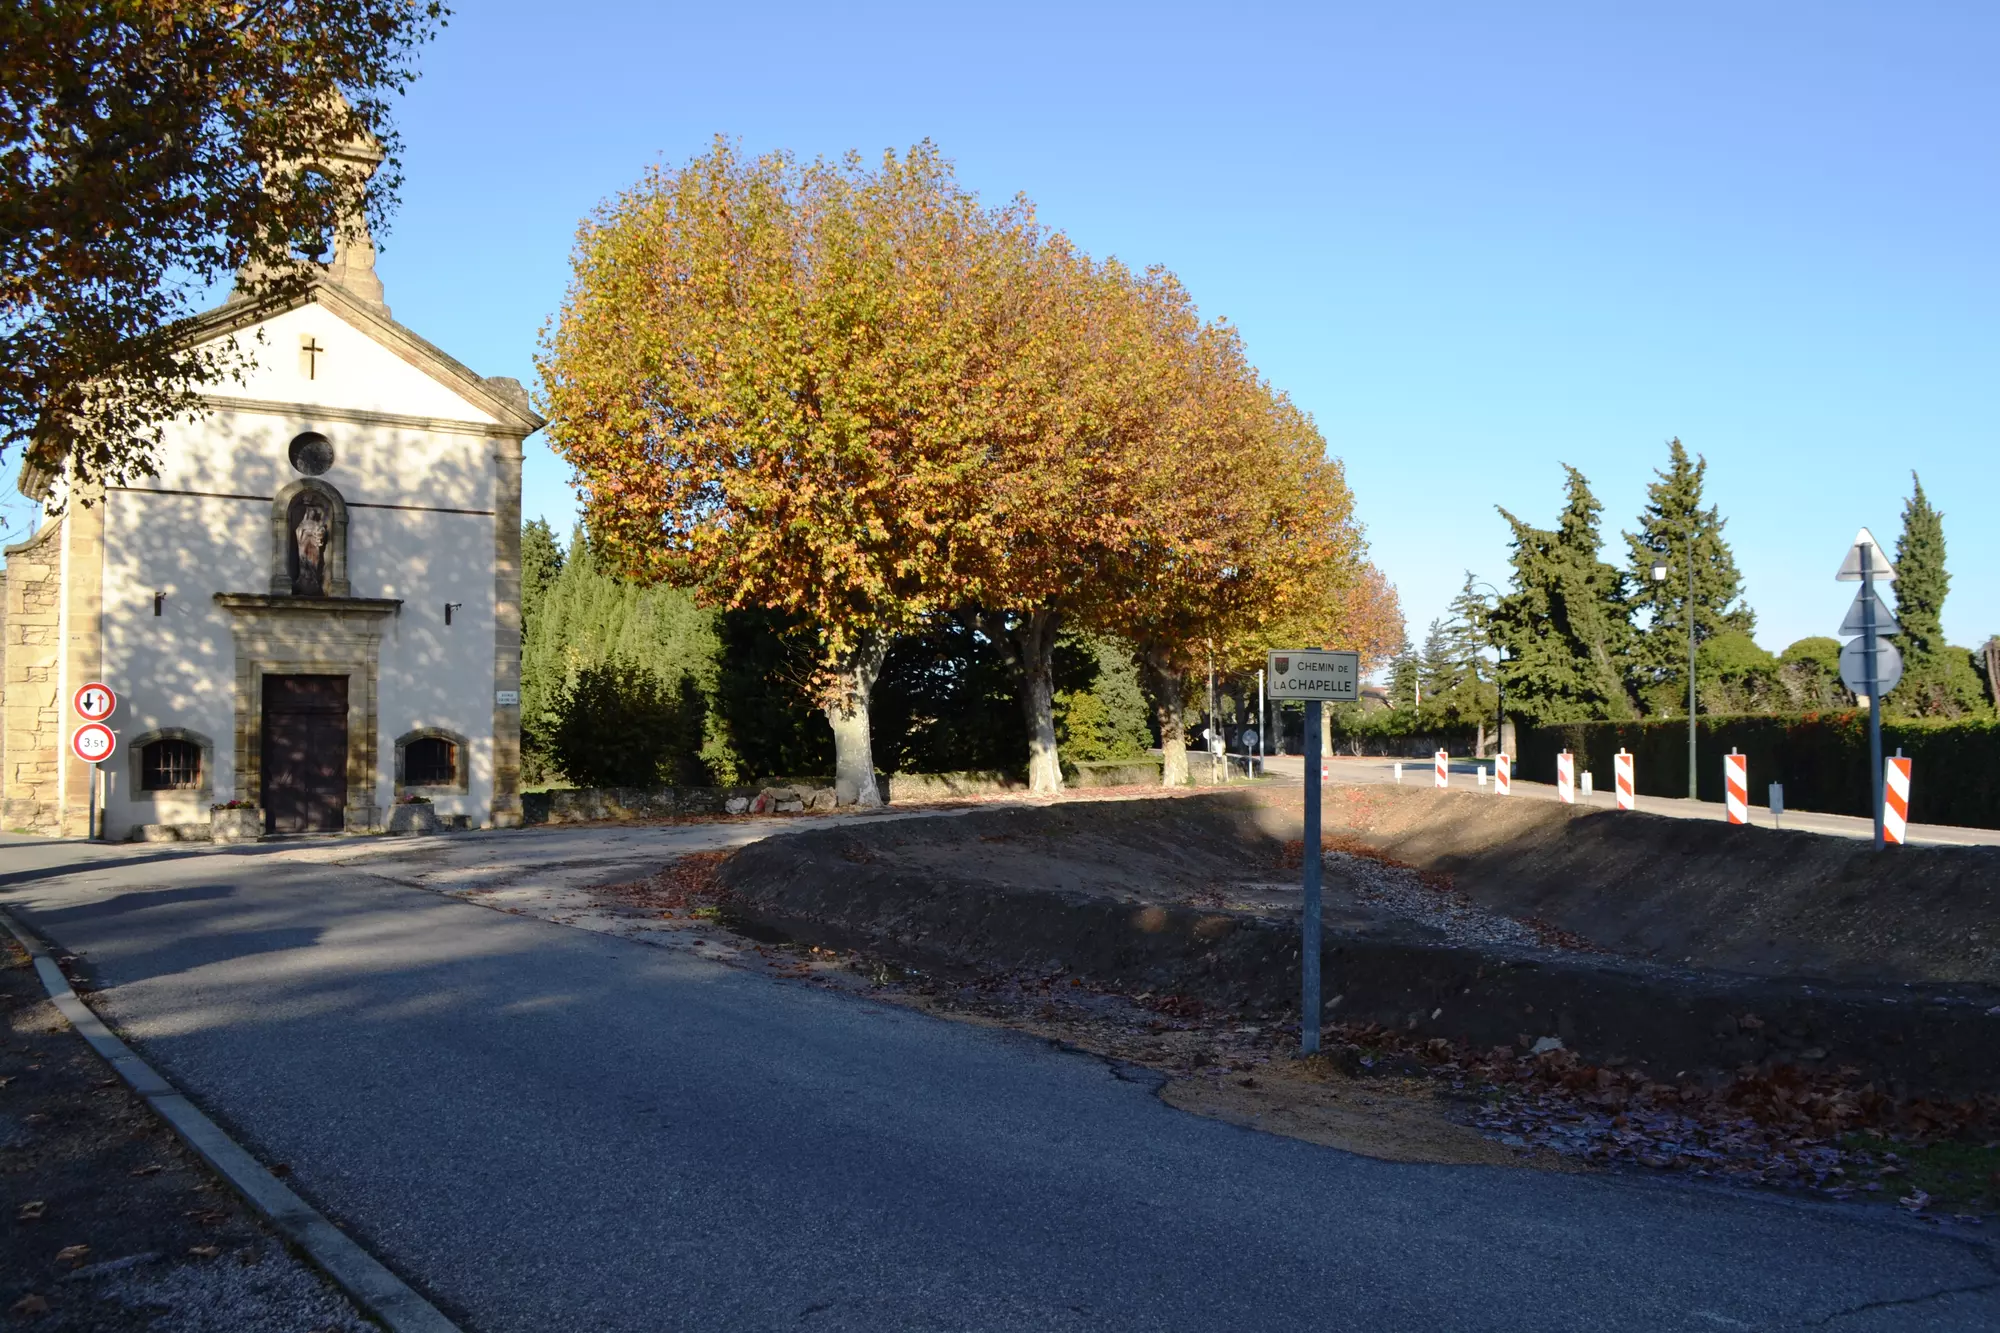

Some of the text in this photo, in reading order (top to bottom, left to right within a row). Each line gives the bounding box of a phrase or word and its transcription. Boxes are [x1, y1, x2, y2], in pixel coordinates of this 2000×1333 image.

[1297, 661, 1349, 673] CHEMIN DE
[1273, 678, 1352, 692] LA CHAPELLE
